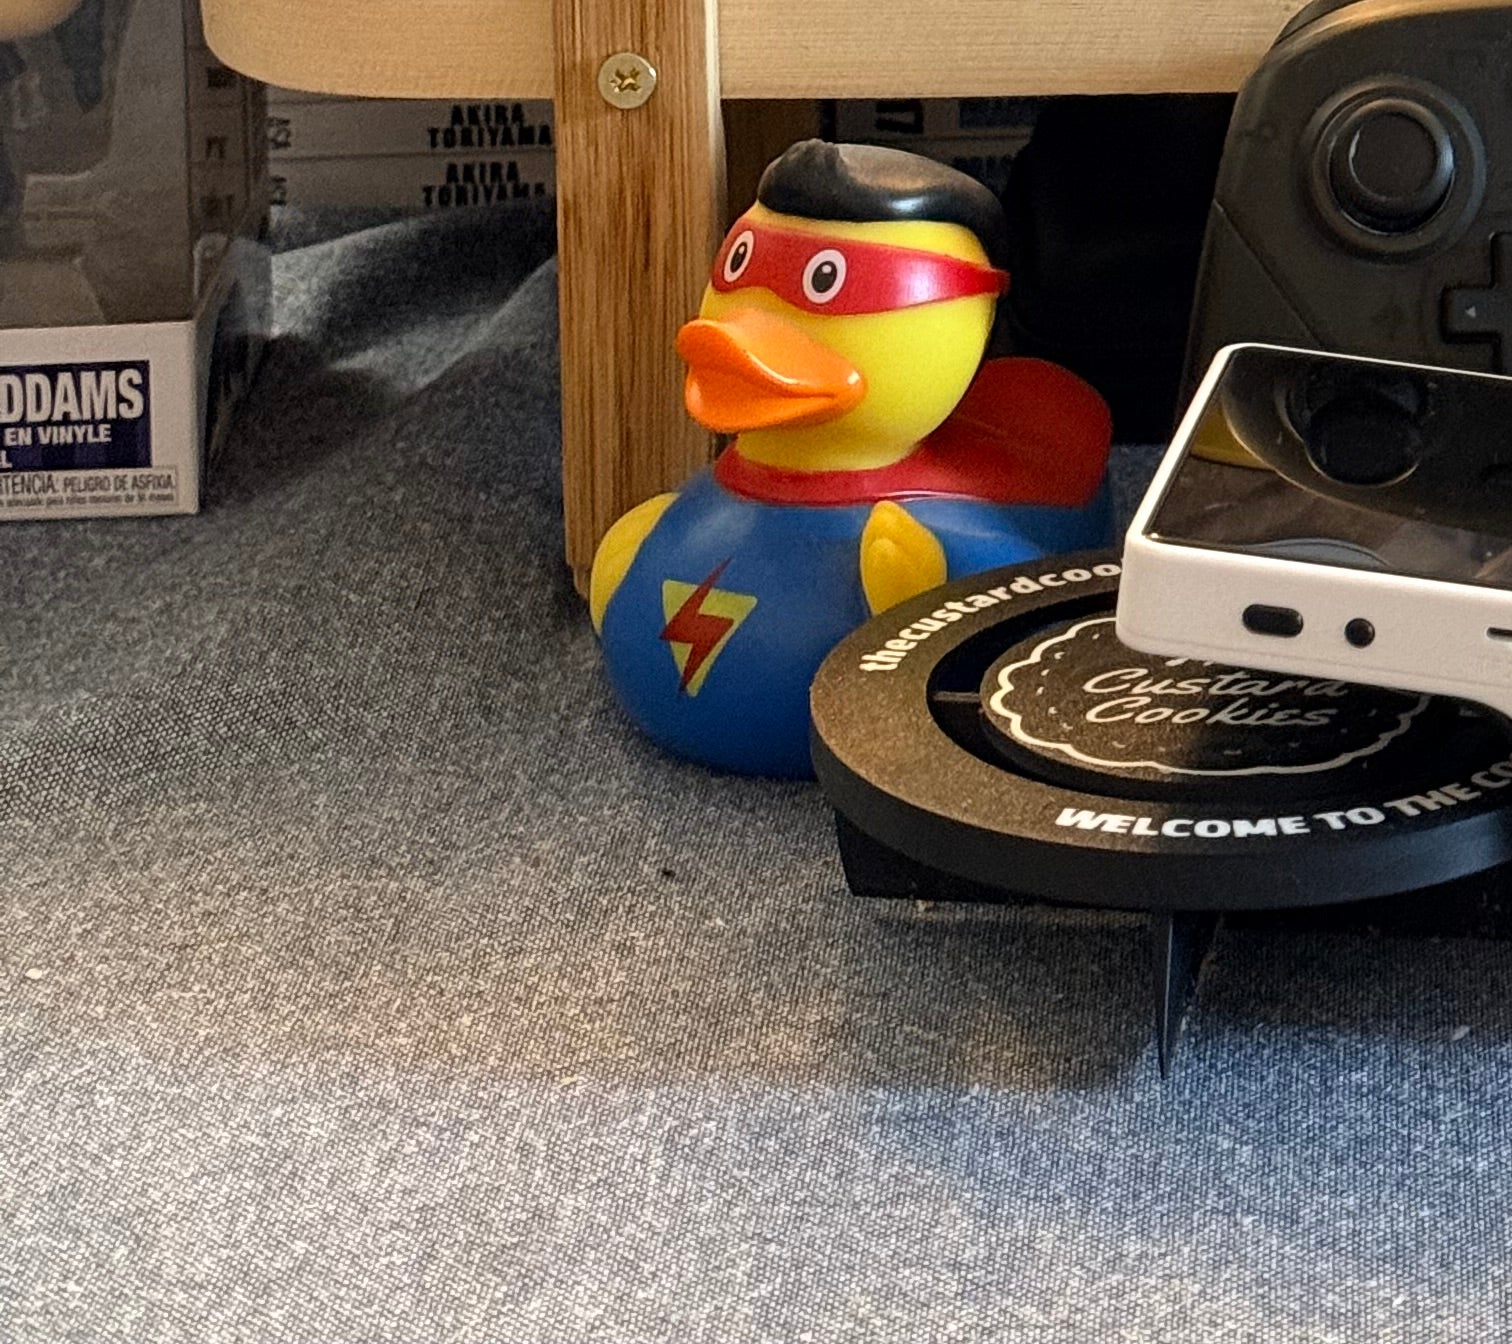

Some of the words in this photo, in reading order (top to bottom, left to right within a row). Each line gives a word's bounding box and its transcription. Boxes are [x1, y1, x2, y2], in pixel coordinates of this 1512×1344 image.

[449, 102, 525, 127] AKIRA
[426, 125, 552, 149] TORIYAMA
[444, 160, 520, 184] AKIRA
[0, 368, 144, 423] DDAMS
[4, 427, 32, 446] EN
[38, 424, 112, 445] VINYLE
[1085, 696, 1339, 726] Cookies
[1055, 807, 1311, 839] WELCOME
[1312, 806, 1386, 832] TO
[1384, 780, 1483, 820] THE
